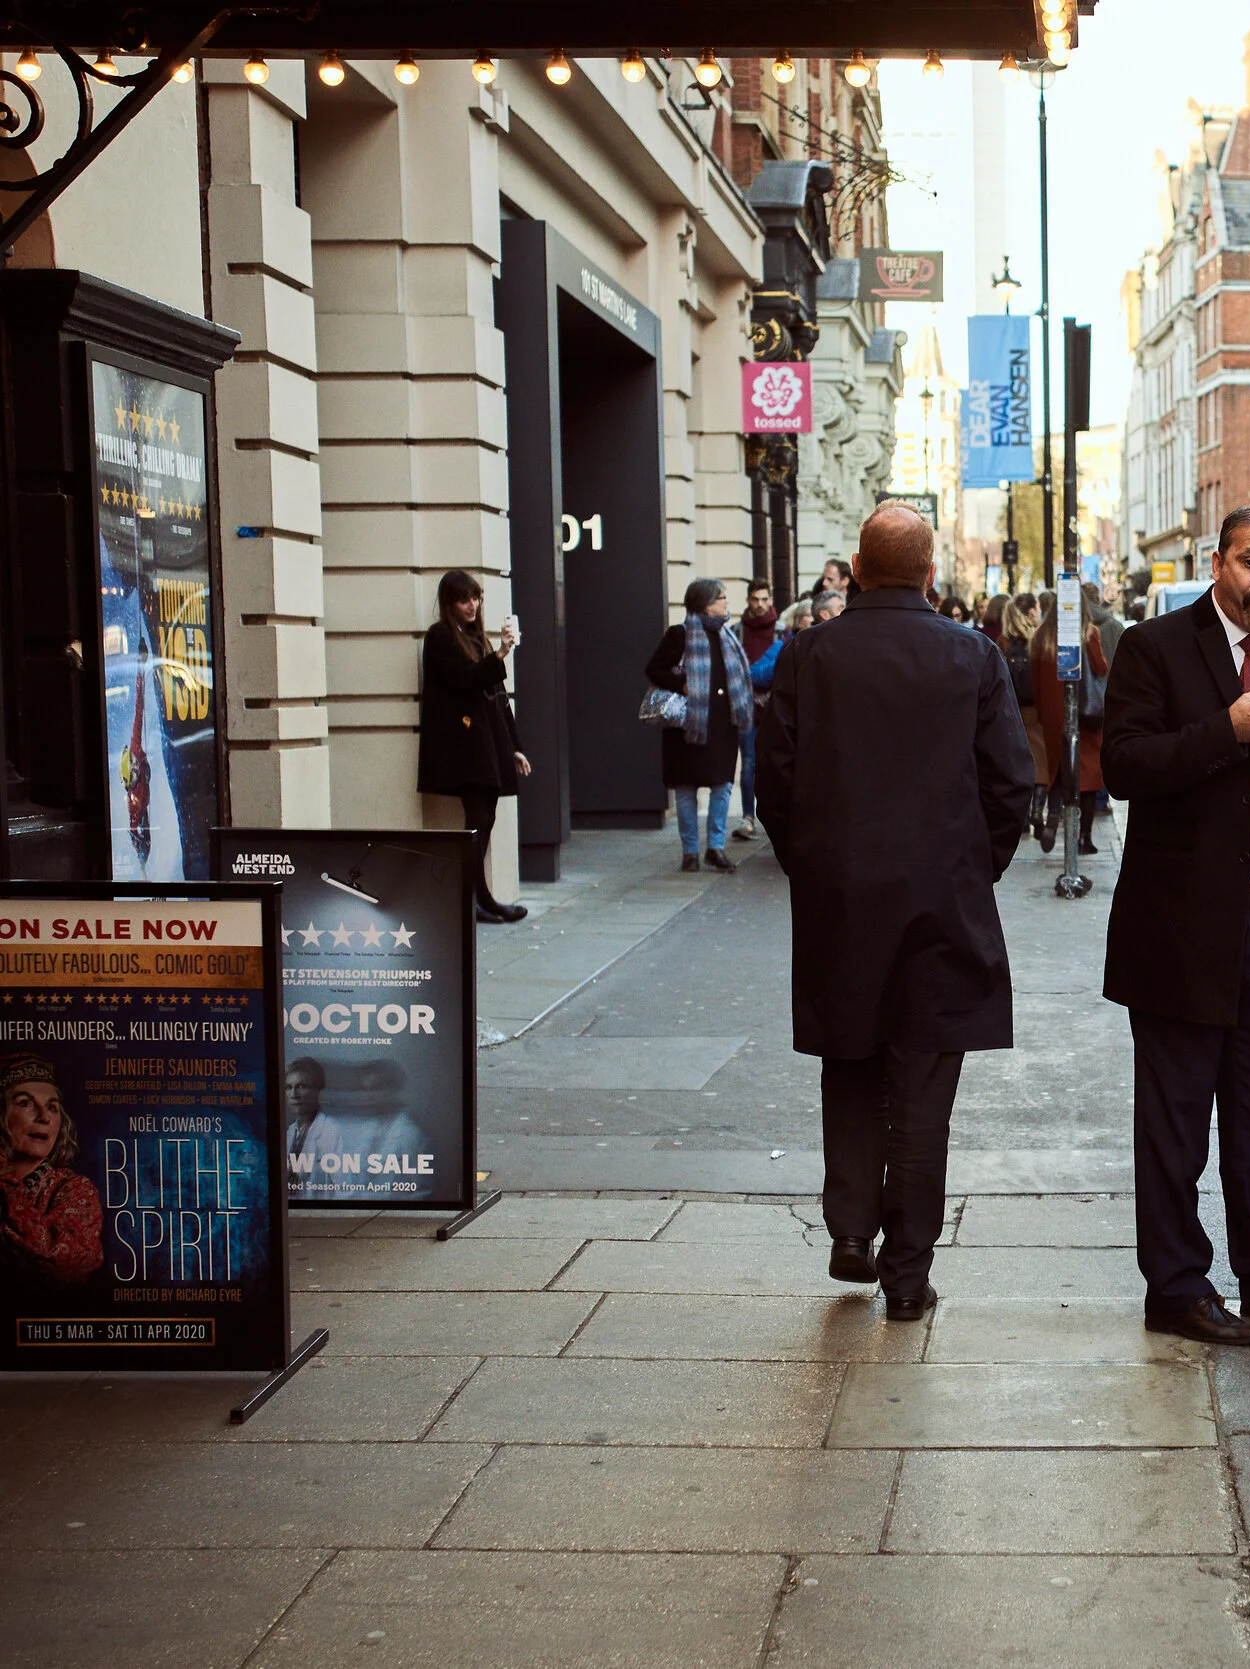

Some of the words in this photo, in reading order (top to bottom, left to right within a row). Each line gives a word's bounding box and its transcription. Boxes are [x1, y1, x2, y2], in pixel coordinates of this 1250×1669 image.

[1009, 348, 1030, 448] HANSEN
[754, 415, 802, 429] tossed
[969, 378, 991, 448] DEAR
[990, 384, 1010, 448] EVAN
[142, 443, 175, 478] CHILLING
[157, 577, 207, 626] TOUCHING
[158, 626, 209, 721] VOID
[231, 863, 266, 875] WEST
[268, 864, 296, 876] END
[235, 853, 291, 865] ALMEIDA
[0, 918, 40, 940] ON
[51, 918, 132, 940] SALE
[142, 919, 219, 941] NOW
[63, 953, 151, 975] FABULOUS...
[155, 953, 204, 975] COMIC
[298, 968, 369, 979] STEVENSON
[371, 969, 432, 980] TRIUMPHS
[283, 1002, 436, 1034] OCTOR
[37, 1020, 126, 1041] SAUNDERS...
[130, 1021, 199, 1041] KILLINGLY
[293, 1036, 330, 1044] CREATED
[341, 1037, 373, 1045] ROBERT
[373, 1037, 392, 1045] ICKE
[104, 1057, 165, 1077] JENNIFER
[168, 1058, 237, 1077] SAUNDERS
[129, 1113, 159, 1133] NOËL
[162, 1116, 223, 1133] COWARD'S
[105, 1137, 248, 1210] BLITHE
[319, 1152, 361, 1174] ON
[366, 1153, 434, 1175] SALE
[305, 1181, 341, 1192] Season
[342, 1181, 366, 1192] from
[367, 1182, 391, 1193] April
[392, 1182, 417, 1192] 2020
[113, 1209, 240, 1282] SPIRIT
[113, 1287, 159, 1301] DIRECTED
[161, 1288, 174, 1301] BY
[176, 1288, 217, 1302] RICHARD
[219, 1288, 243, 1302] EYRE
[27, 1324, 50, 1339] THU
[55, 1324, 62, 1339] 5
[67, 1324, 94, 1339] MAR
[107, 1324, 130, 1339] SAT
[133, 1324, 143, 1339] 11
[147, 1324, 171, 1339] APR
[175, 1324, 206, 1340] 2020
